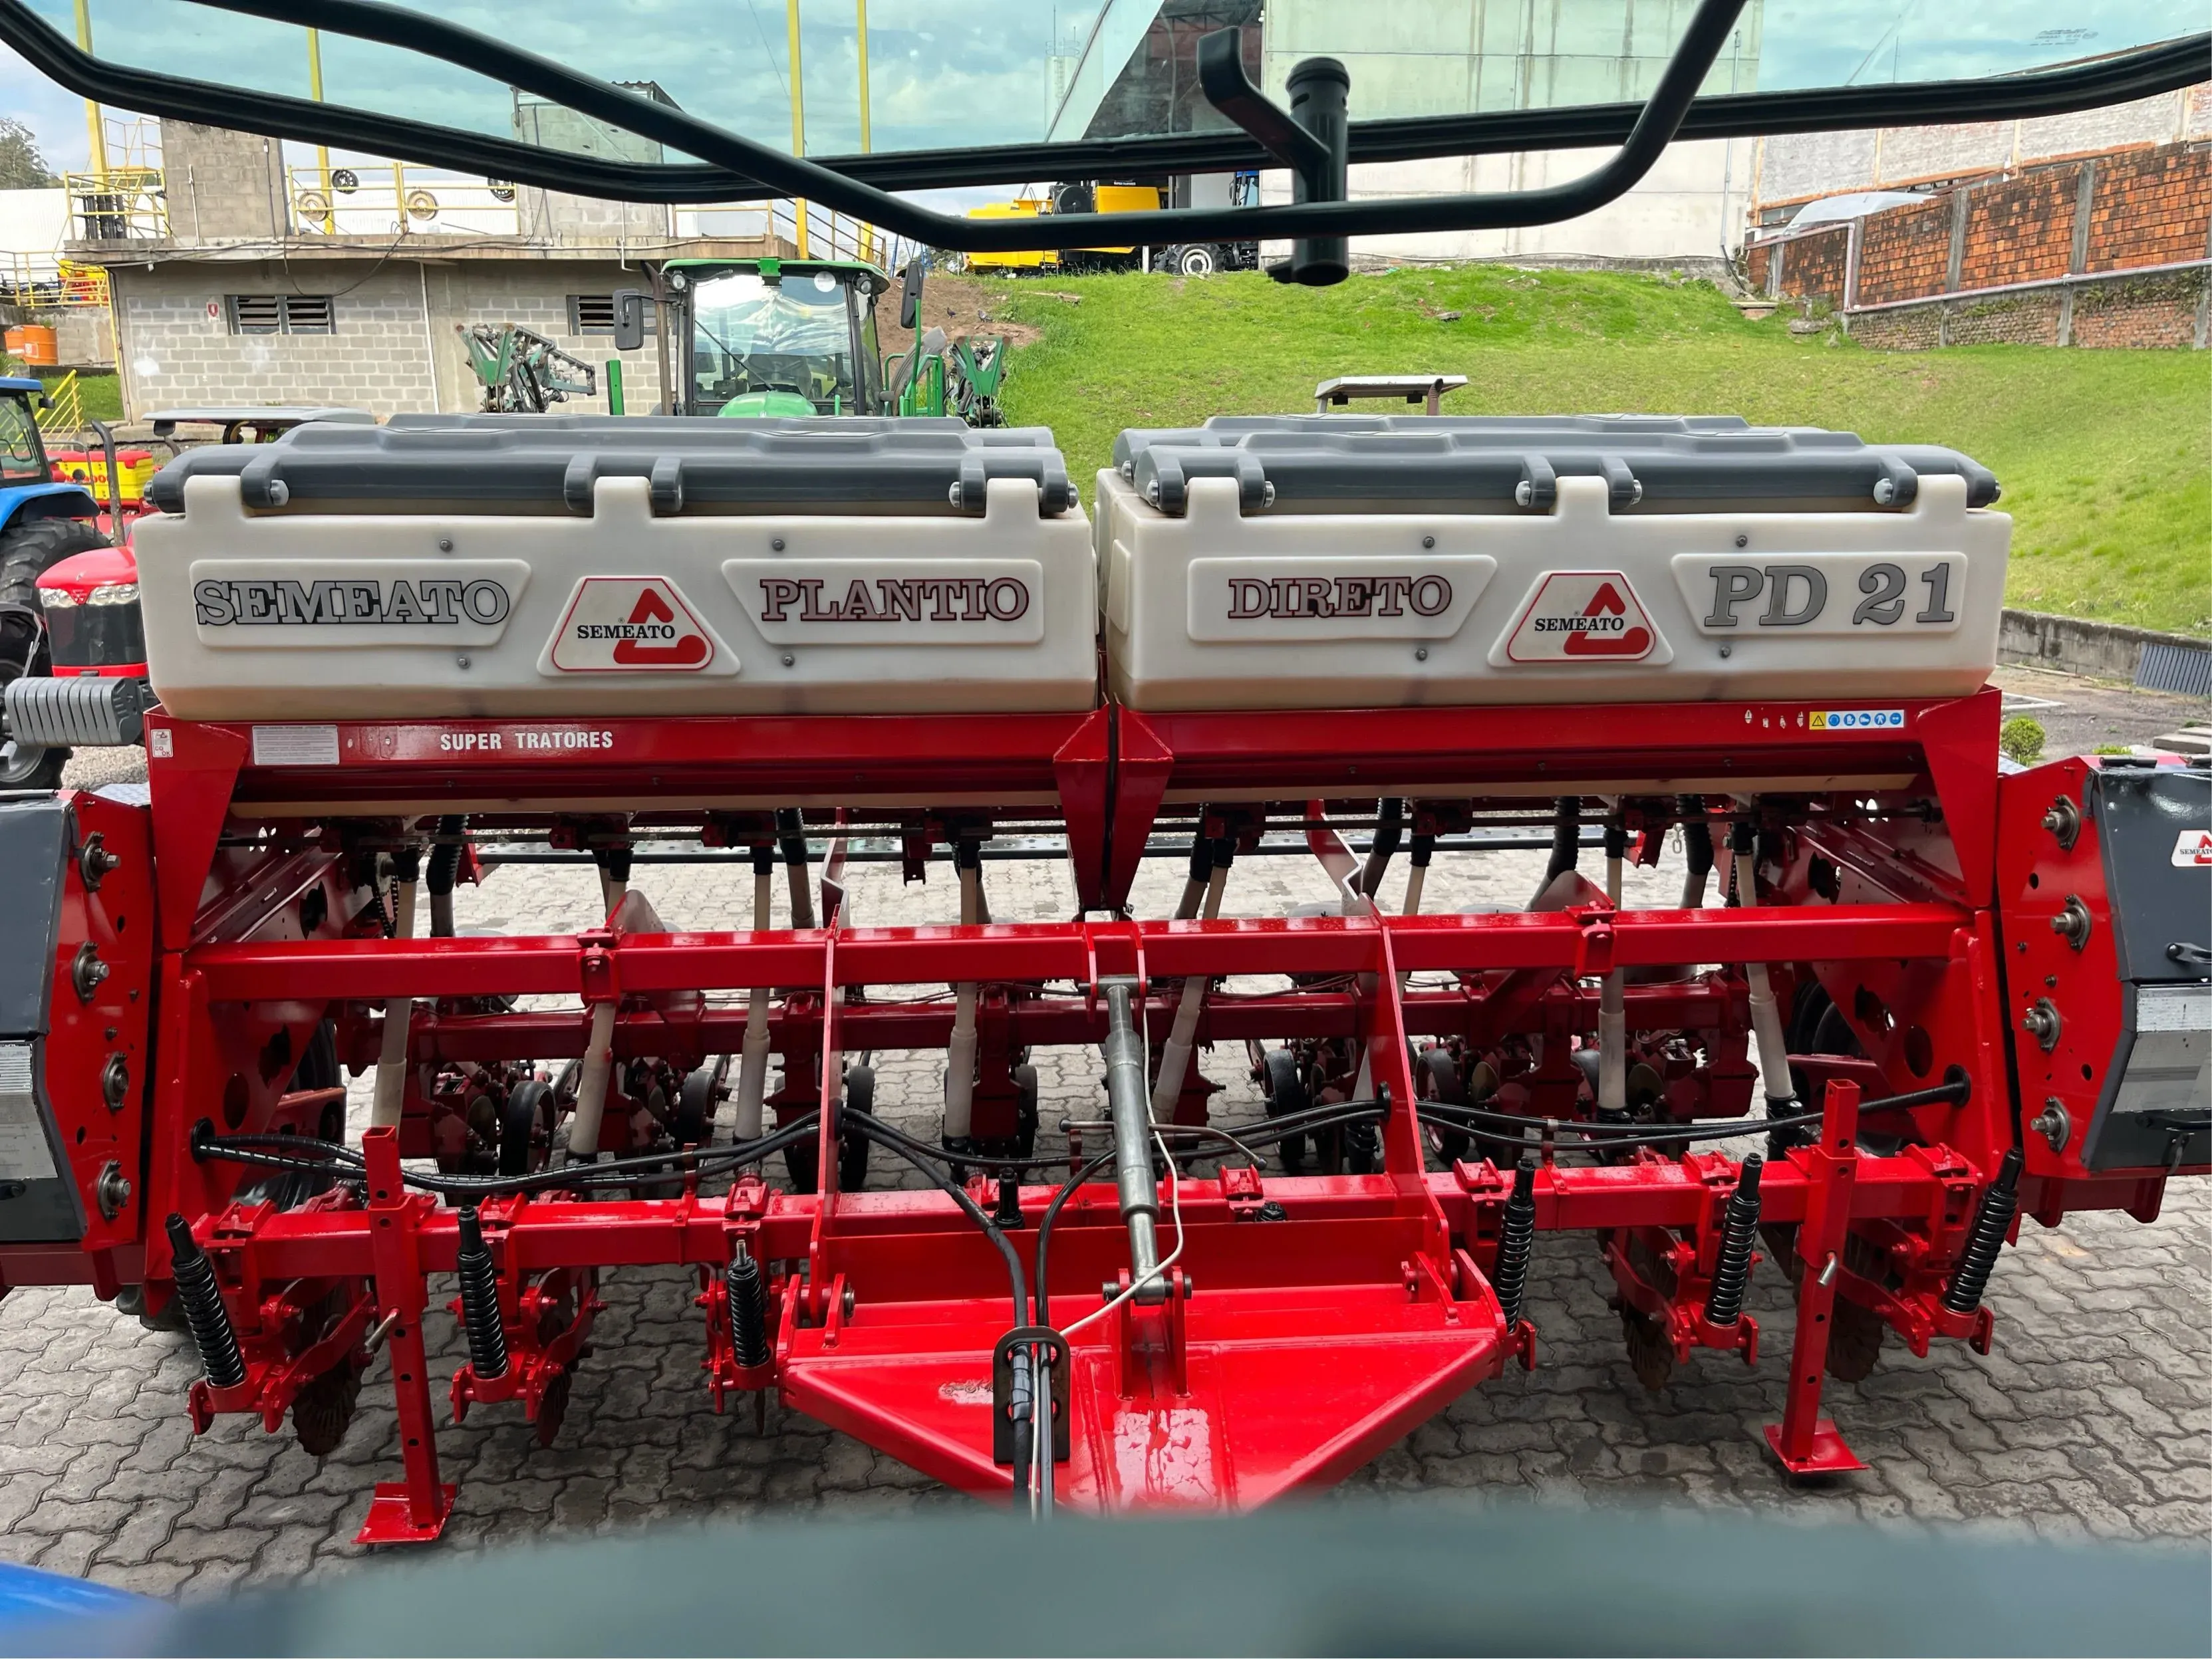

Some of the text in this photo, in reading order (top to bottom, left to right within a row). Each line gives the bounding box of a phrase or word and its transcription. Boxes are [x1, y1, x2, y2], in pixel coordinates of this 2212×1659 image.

[194, 579, 510, 625] SEMEATO
[760, 577, 1030, 622] PLANTIO
[1228, 574, 1452, 619] DIRETO
[1704, 563, 1955, 627] PD 21
[577, 624, 676, 639] SEMEATO
[1534, 617, 1624, 632] SEMEATO
[440, 731, 613, 751] SUPER TRATORES
